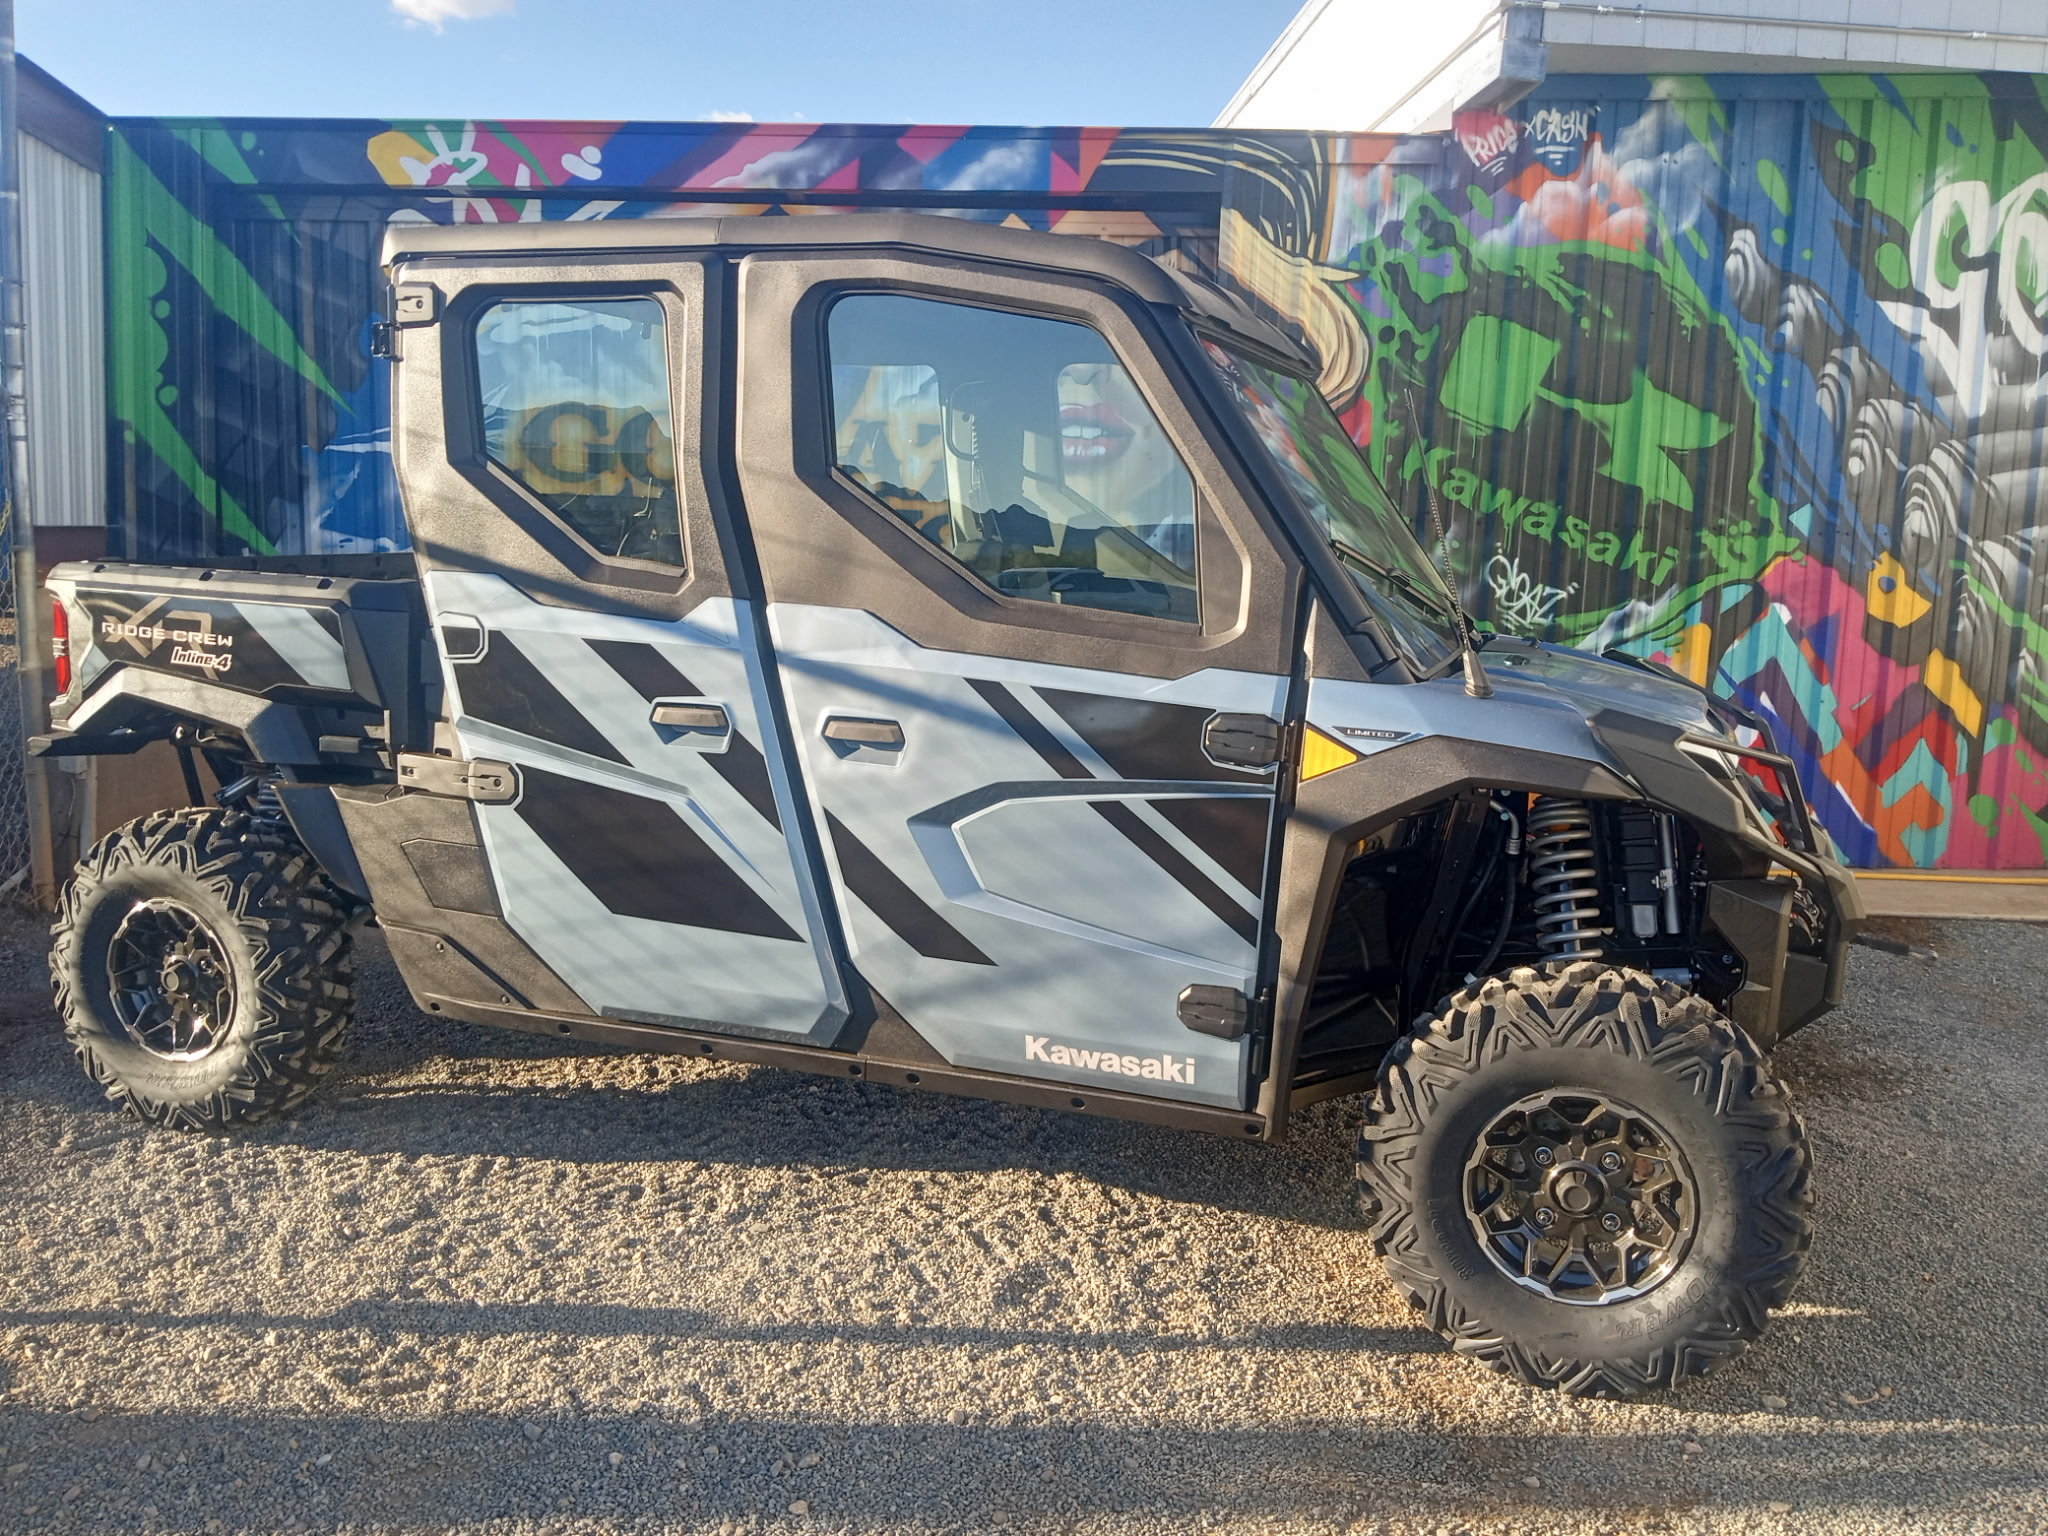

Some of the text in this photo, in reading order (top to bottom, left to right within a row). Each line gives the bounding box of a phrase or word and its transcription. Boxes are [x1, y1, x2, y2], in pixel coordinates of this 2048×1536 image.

[1399, 437, 1680, 587] Kawasaki
[101, 621, 233, 647] RIDGE CREW
[1346, 728, 1395, 738] LIMITED
[1025, 1034, 1196, 1085] Kawasaki
[1615, 1255, 1722, 1341] POWER
